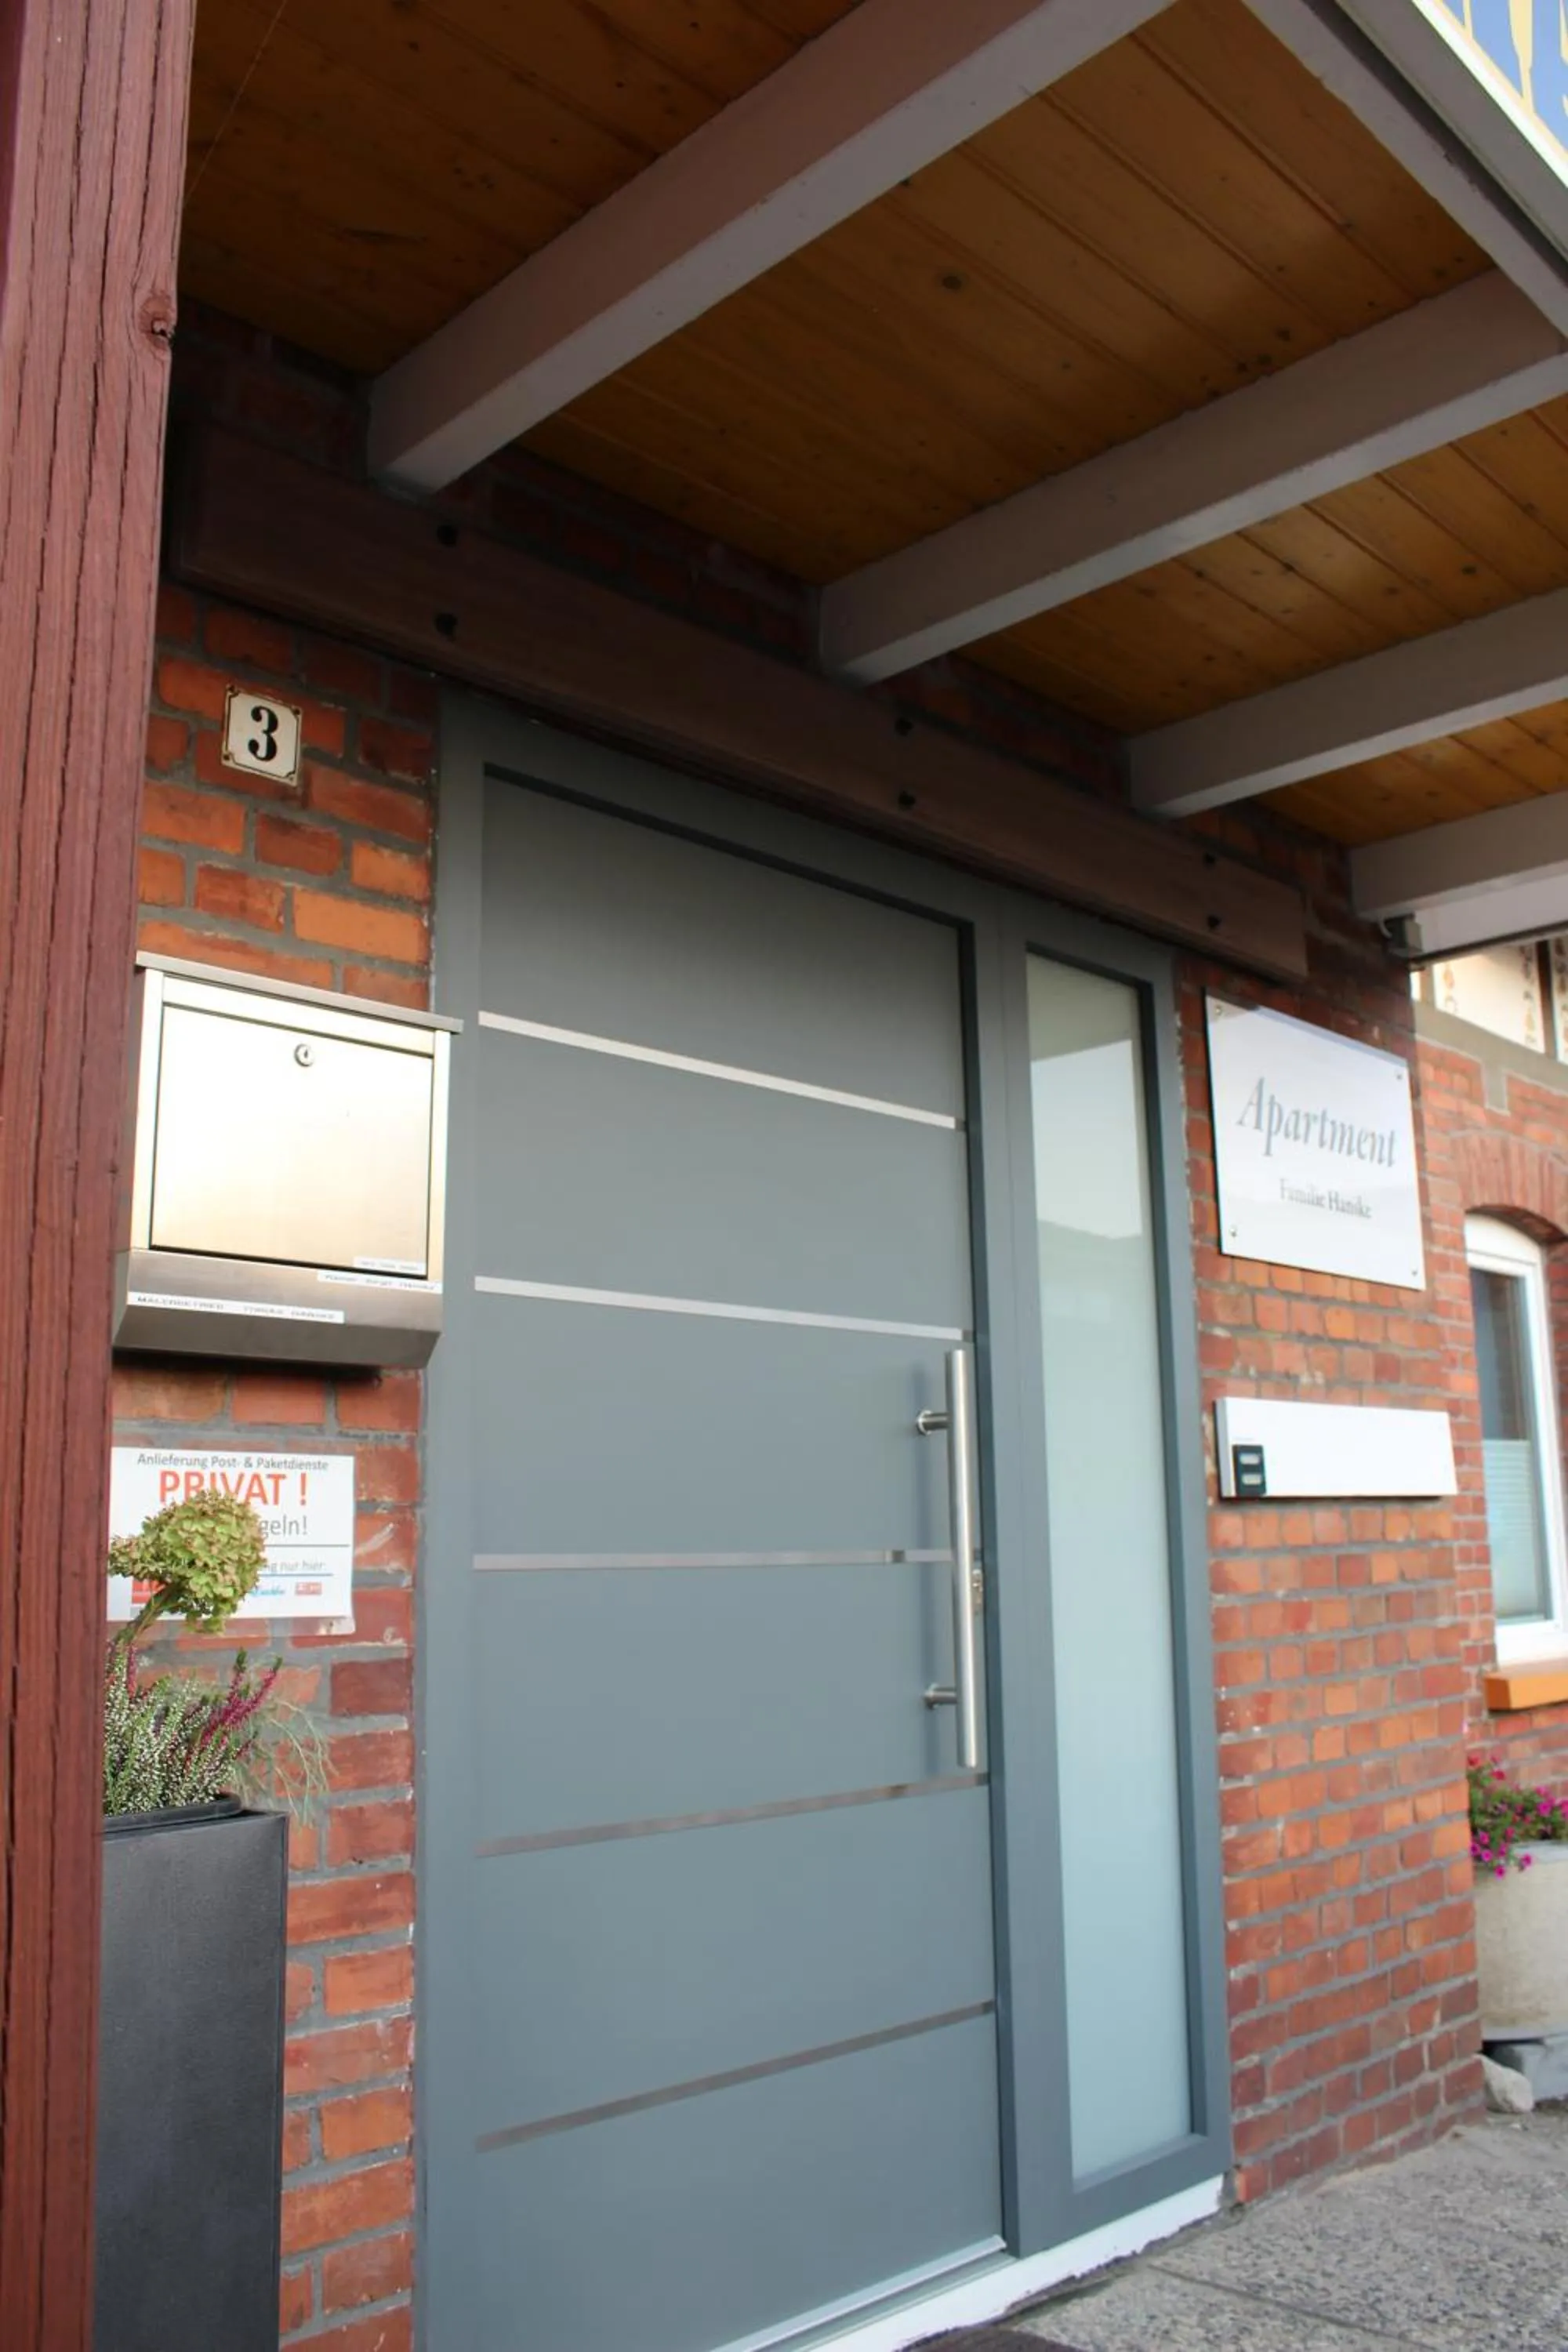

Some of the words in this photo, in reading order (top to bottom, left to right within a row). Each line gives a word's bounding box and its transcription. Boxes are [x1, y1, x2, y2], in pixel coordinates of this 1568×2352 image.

[248, 706, 278, 762] 3
[1236, 1076, 1396, 1167] Apartment
[137, 1453, 208, 1469] Anlieferung
[211, 1456, 241, 1468] Post-
[244, 1456, 253, 1468] &
[256, 1457, 328, 1471] Paketdienste
[159, 1470, 286, 1506] PRIVAT
[299, 1472, 307, 1506] !
